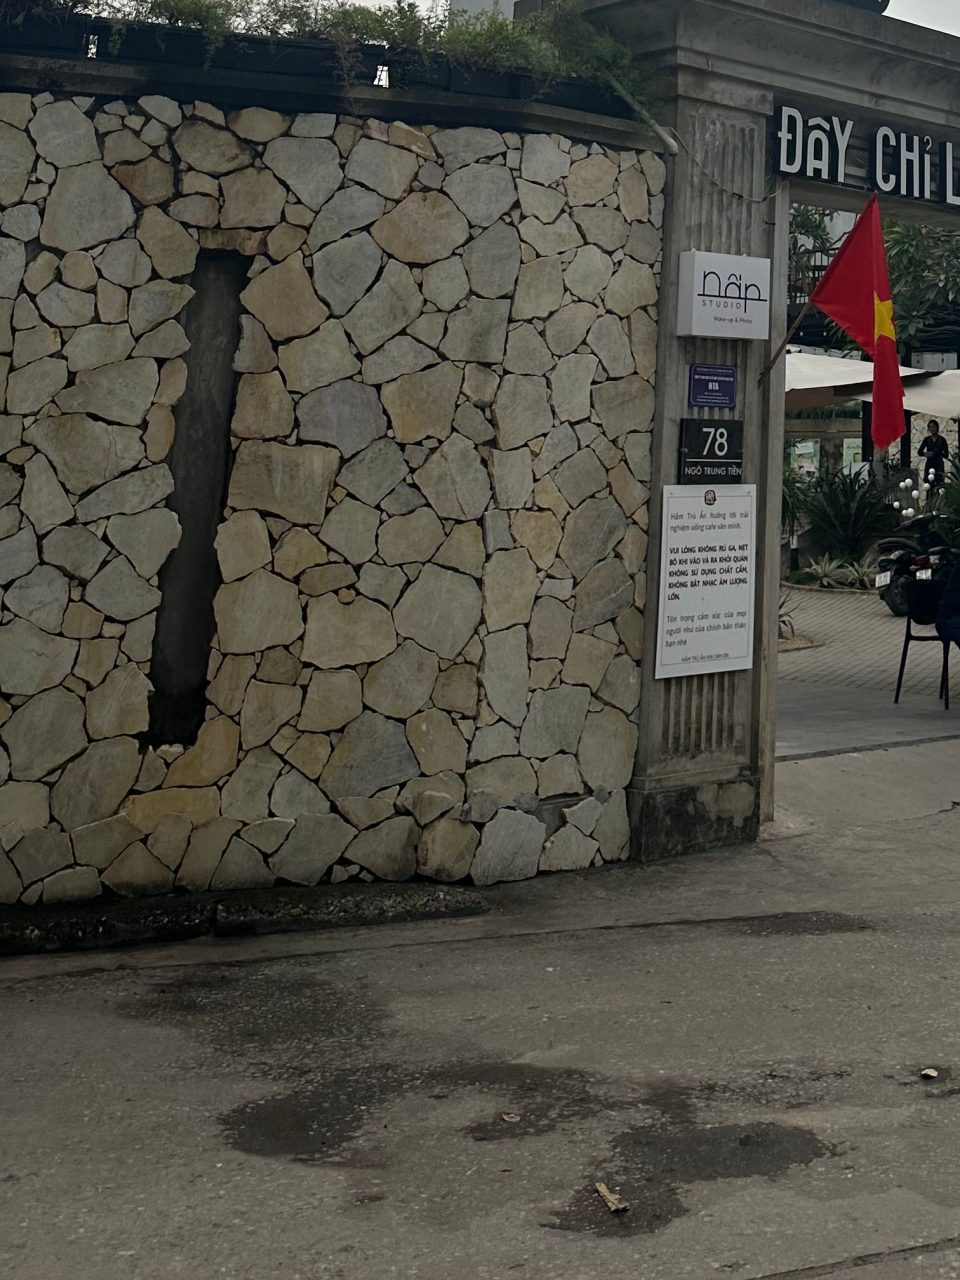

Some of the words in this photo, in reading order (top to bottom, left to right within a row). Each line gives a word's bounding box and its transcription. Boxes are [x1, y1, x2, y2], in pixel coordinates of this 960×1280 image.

[778, 106, 854, 183] ĐÂY
[876, 126, 932, 199] CHỈ
[702, 300, 741, 309] STUDIO
[703, 428, 727, 456] 78
[728, 465, 741, 475] TIỀN
[669, 581, 688, 589] KHÔNG
